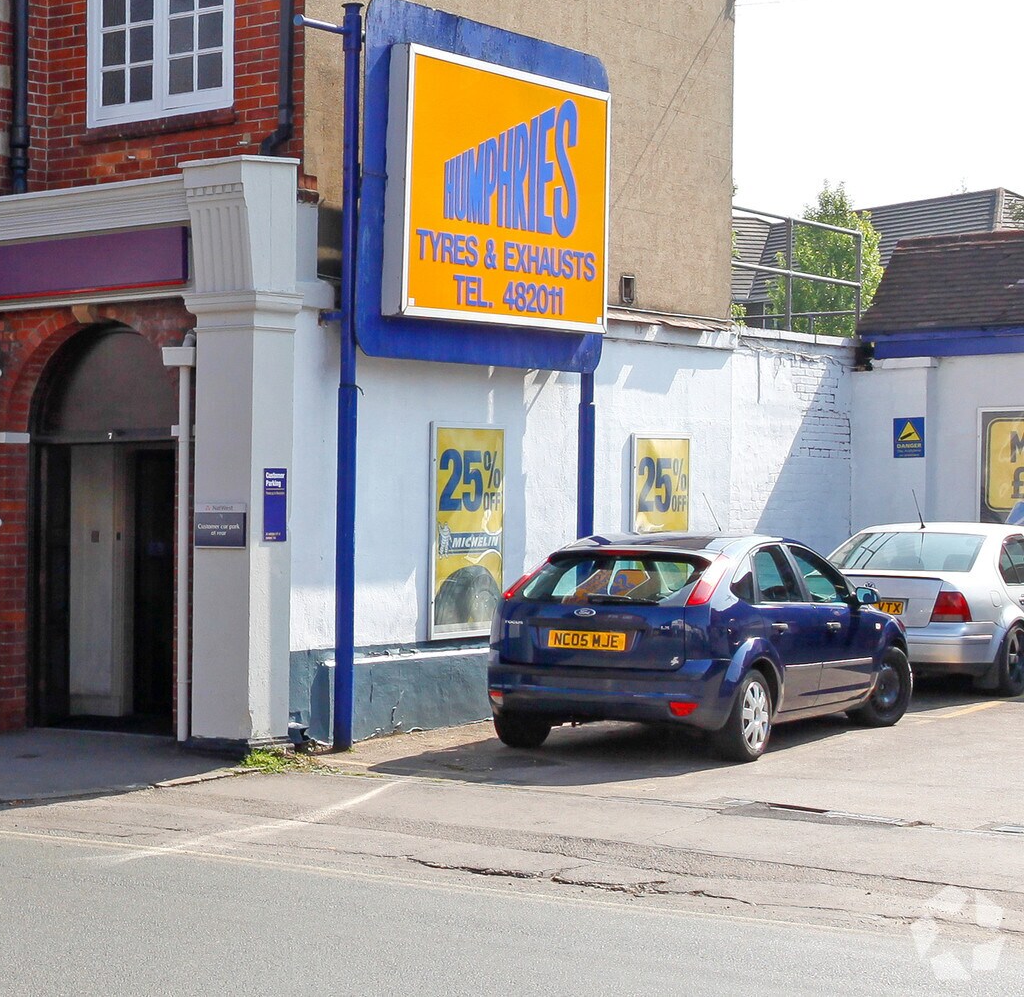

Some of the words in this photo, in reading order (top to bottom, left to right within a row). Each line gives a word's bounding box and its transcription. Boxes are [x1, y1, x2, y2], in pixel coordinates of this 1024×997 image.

[444, 99, 578, 239] HUMPHRIES
[416, 229, 479, 267] TYRES
[484, 239, 497, 270] &
[504, 242, 596, 281] EXHAUSTS
[453, 274, 493, 308] TEL.
[503, 281, 564, 315] 482011
[438, 448, 501, 512] 25%
[483, 491, 501, 511] OFF
[638, 456, 687, 513] 25%
[671, 495, 687, 512] OFF
[451, 536, 500, 548] MICHELIN
[878, 602, 901, 613] VTX
[553, 633, 588, 646] NC05
[592, 636, 618, 648] MJE
